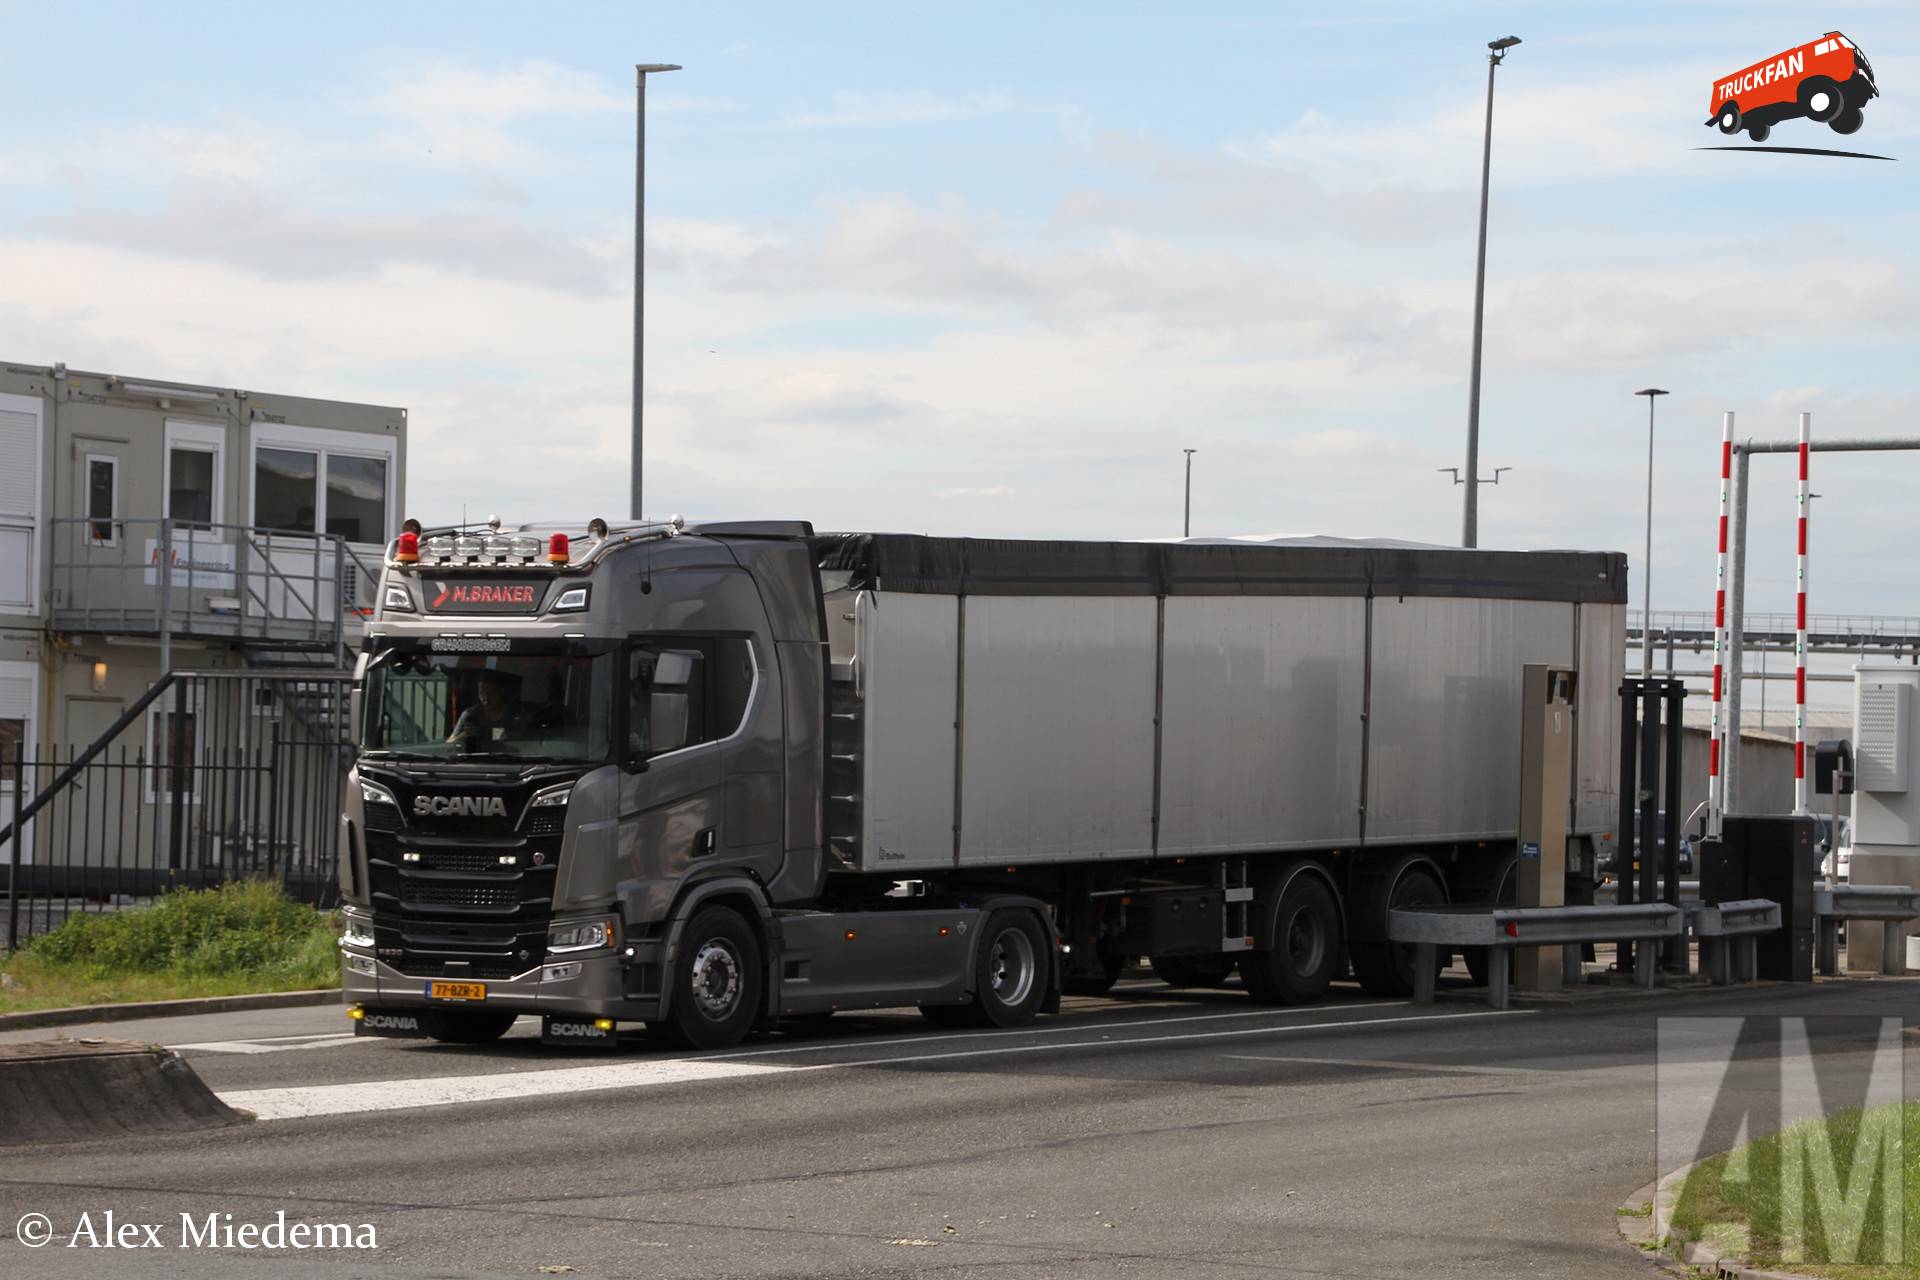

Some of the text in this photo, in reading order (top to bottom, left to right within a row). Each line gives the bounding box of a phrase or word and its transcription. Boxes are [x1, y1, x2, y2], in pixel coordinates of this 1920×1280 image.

[451, 585, 535, 604] M.BRAKER
[413, 795, 508, 817] SCANIA
[435, 984, 481, 998] 77-BZR-2
[363, 1014, 419, 1030] SCANIA
